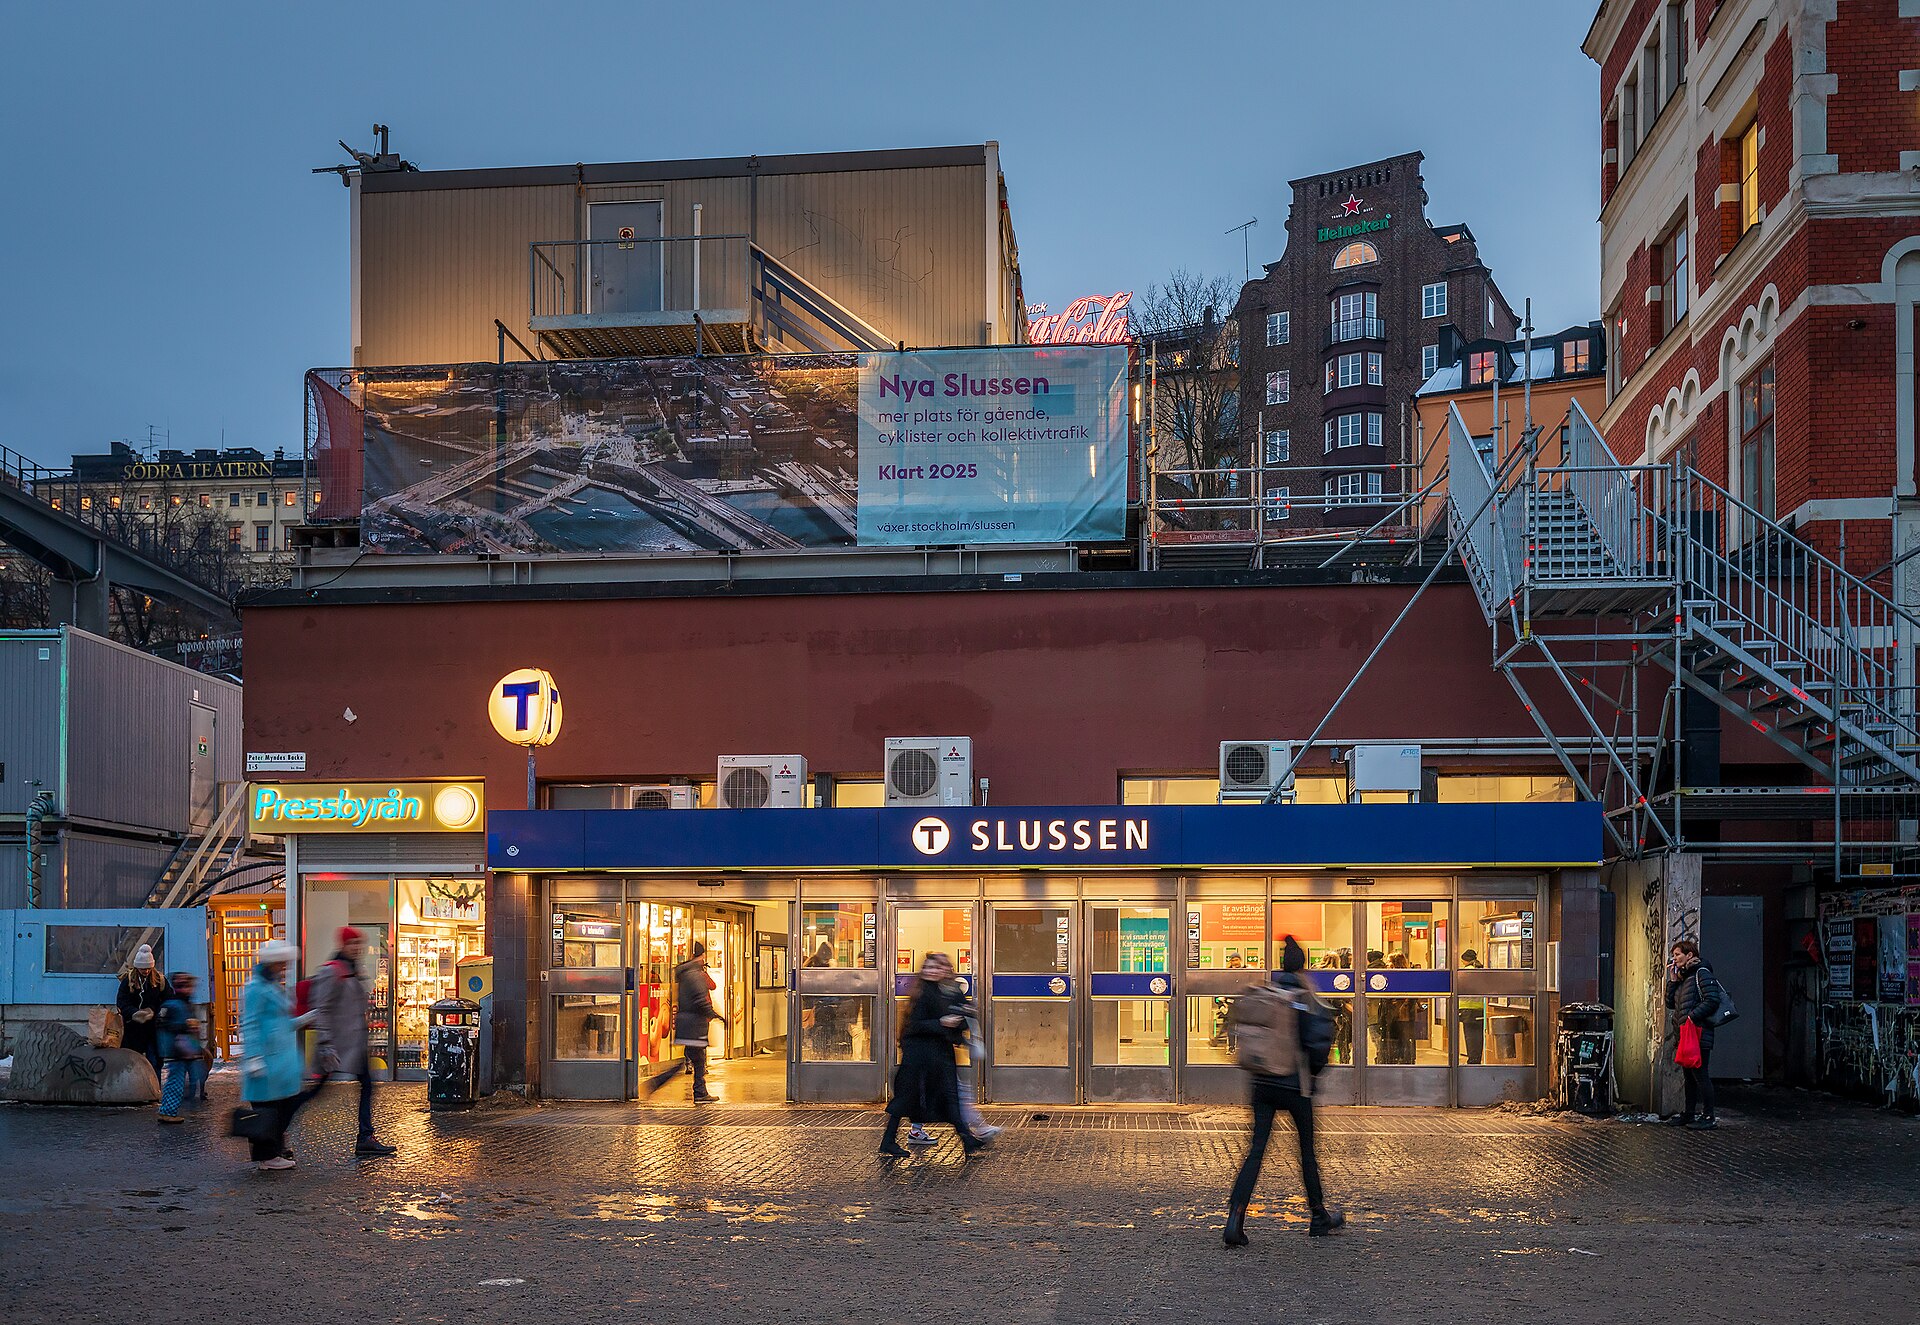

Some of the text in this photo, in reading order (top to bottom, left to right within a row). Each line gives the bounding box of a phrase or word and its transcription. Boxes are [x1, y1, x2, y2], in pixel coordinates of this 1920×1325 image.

[1317, 217, 1389, 243] Heineken
[879, 372, 1049, 402] Nya Slussen
[878, 406, 1050, 425] mer plats för gående,
[878, 425, 1089, 446] cyklister och kollektivtrafik
[123, 461, 273, 480] SÖDRA TEATERN
[878, 463, 978, 481] Klart 2025
[877, 520, 1016, 533] växer.stockholm/slussen
[502, 680, 540, 732] T
[254, 788, 420, 827] Pressbyrån
[971, 819, 1149, 851] SLUSSEN
